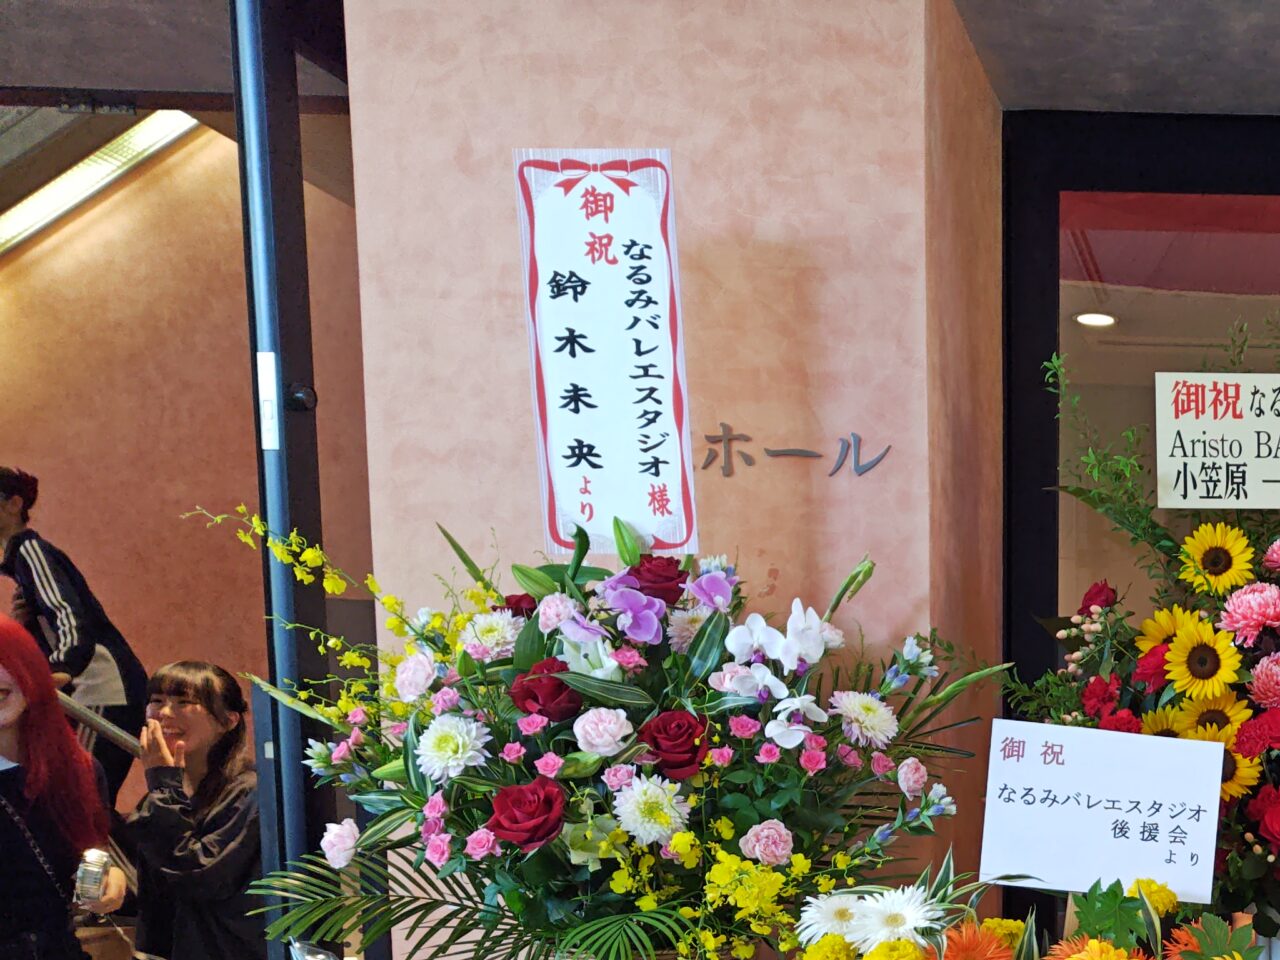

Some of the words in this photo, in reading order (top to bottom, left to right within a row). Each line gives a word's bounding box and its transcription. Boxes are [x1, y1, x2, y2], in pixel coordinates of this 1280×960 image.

[579, 185, 619, 265] 御祝
[1171, 380, 1244, 421] 御祝
[701, 421, 892, 477] ホール
[1168, 429, 1243, 459] Aristo
[997, 782, 1208, 823] なるみバレエスタジオ
[1164, 848, 1199, 867] より
